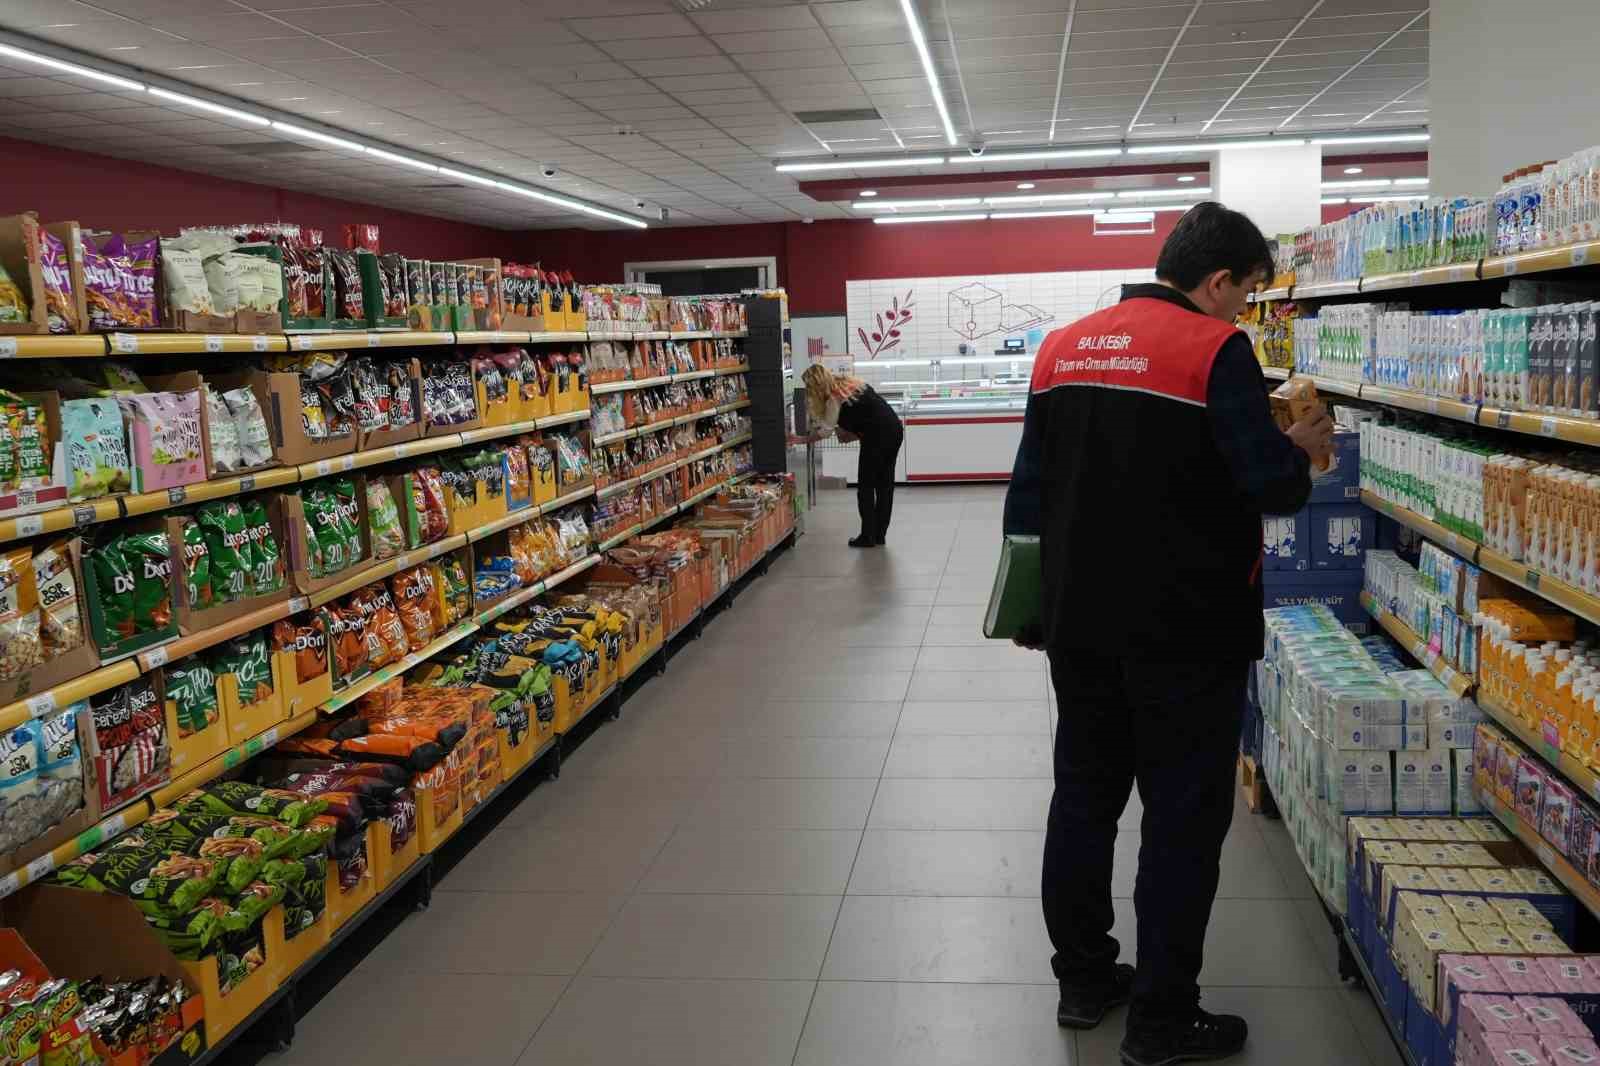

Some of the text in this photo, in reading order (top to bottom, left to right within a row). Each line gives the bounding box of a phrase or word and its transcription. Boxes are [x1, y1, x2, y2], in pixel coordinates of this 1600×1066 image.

[1077, 332, 1131, 349] BALIKESİR
[1076, 360, 1085, 370] ve
[1085, 357, 1109, 370] Orman
[1110, 356, 1148, 373] Müdürlüğü
[230, 569, 245, 593] 20
[256, 561, 273, 583] 20
